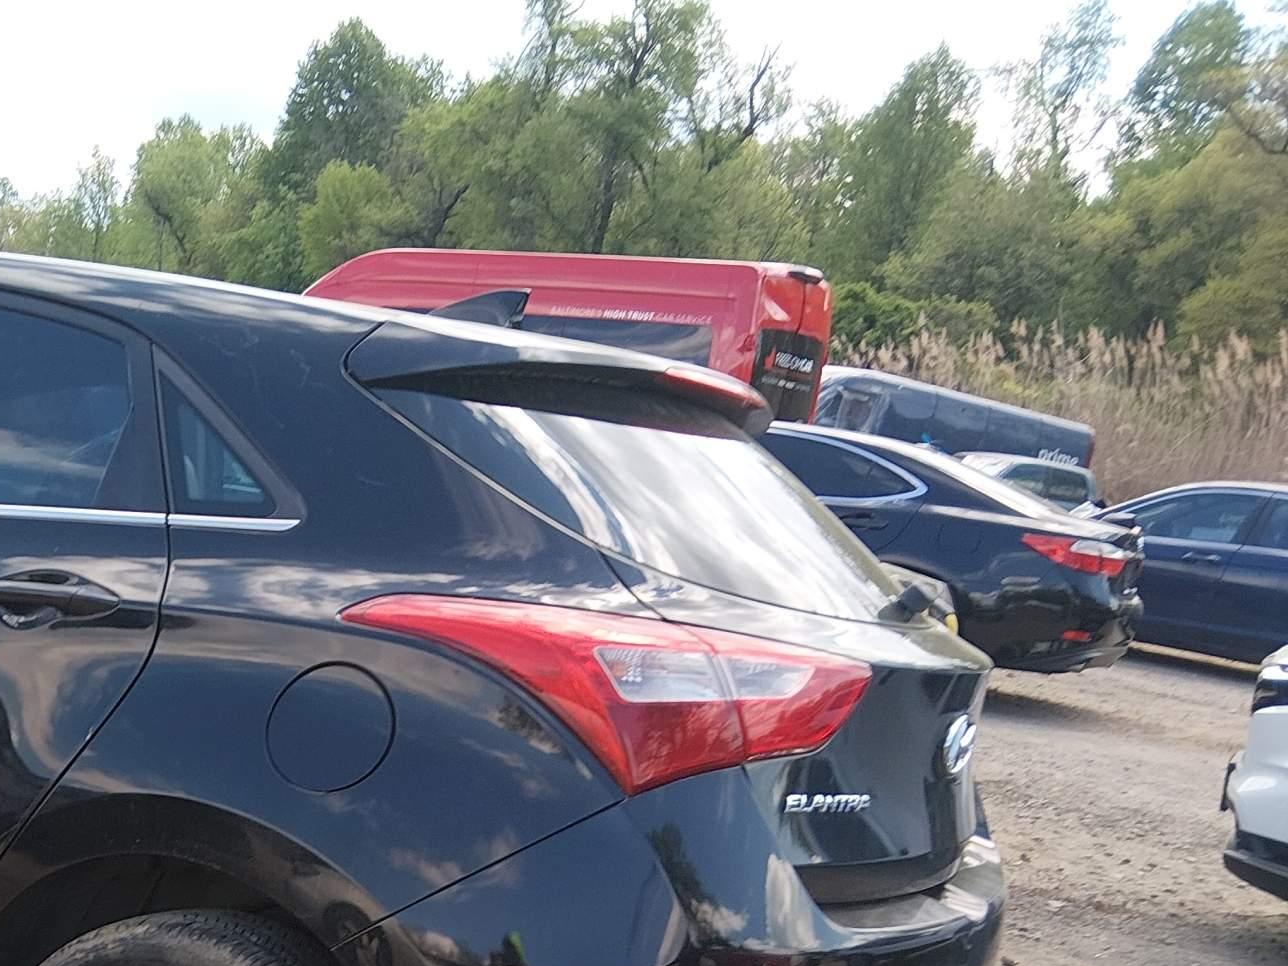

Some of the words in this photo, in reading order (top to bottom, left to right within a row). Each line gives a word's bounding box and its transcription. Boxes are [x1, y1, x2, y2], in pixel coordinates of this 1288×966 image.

[603, 309, 627, 319] HIGH
[627, 310, 656, 321] TRUST
[1038, 447, 1079, 465] prime
[784, 794, 871, 813] ELANTRA
